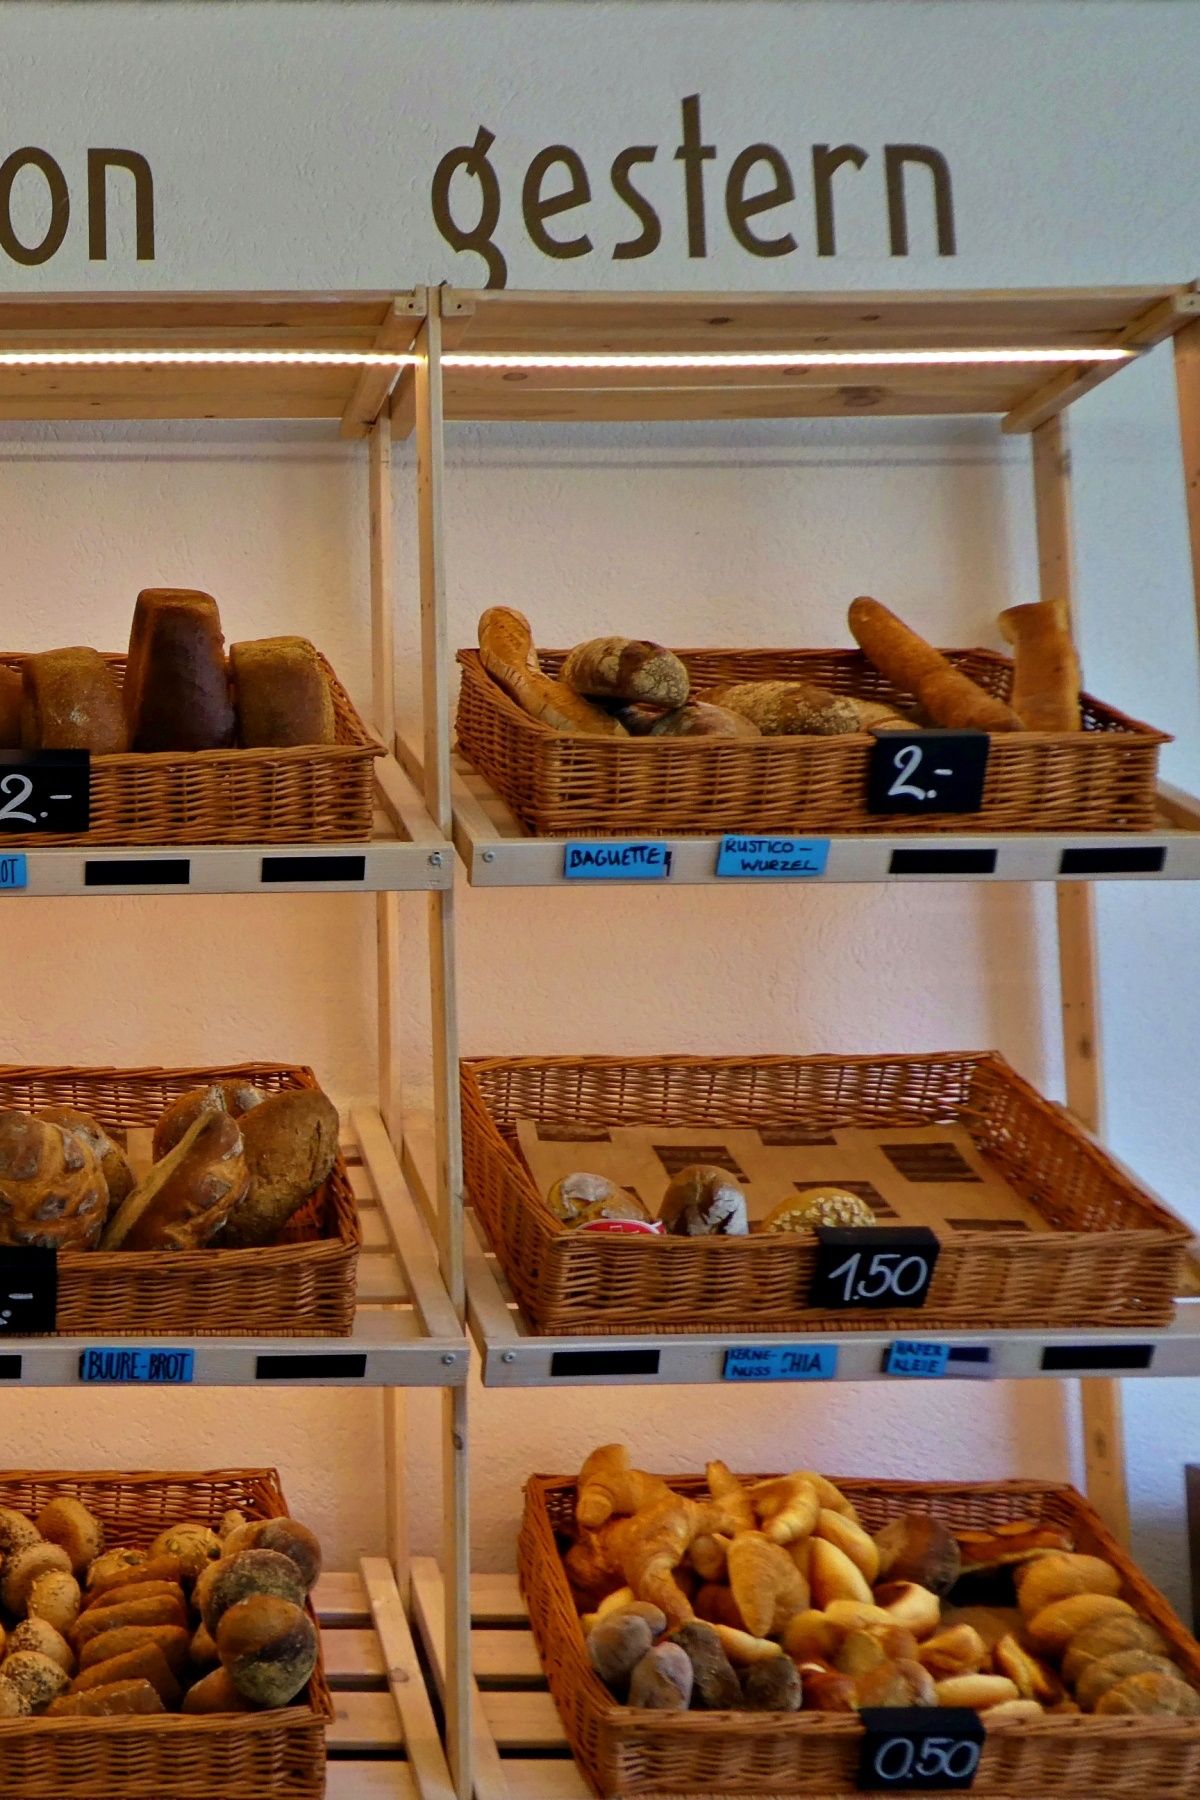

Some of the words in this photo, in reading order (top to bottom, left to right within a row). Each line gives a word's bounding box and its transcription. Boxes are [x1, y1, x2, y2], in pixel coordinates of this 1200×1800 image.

[431, 92, 957, 289] gestern
[887, 744, 954, 801] 2.-
[569, 845, 661, 868] BAGUETTE
[740, 858, 819, 872] WURZEL
[828, 1252, 930, 1302] 1.50
[874, 1736, 981, 1780] 0.50
